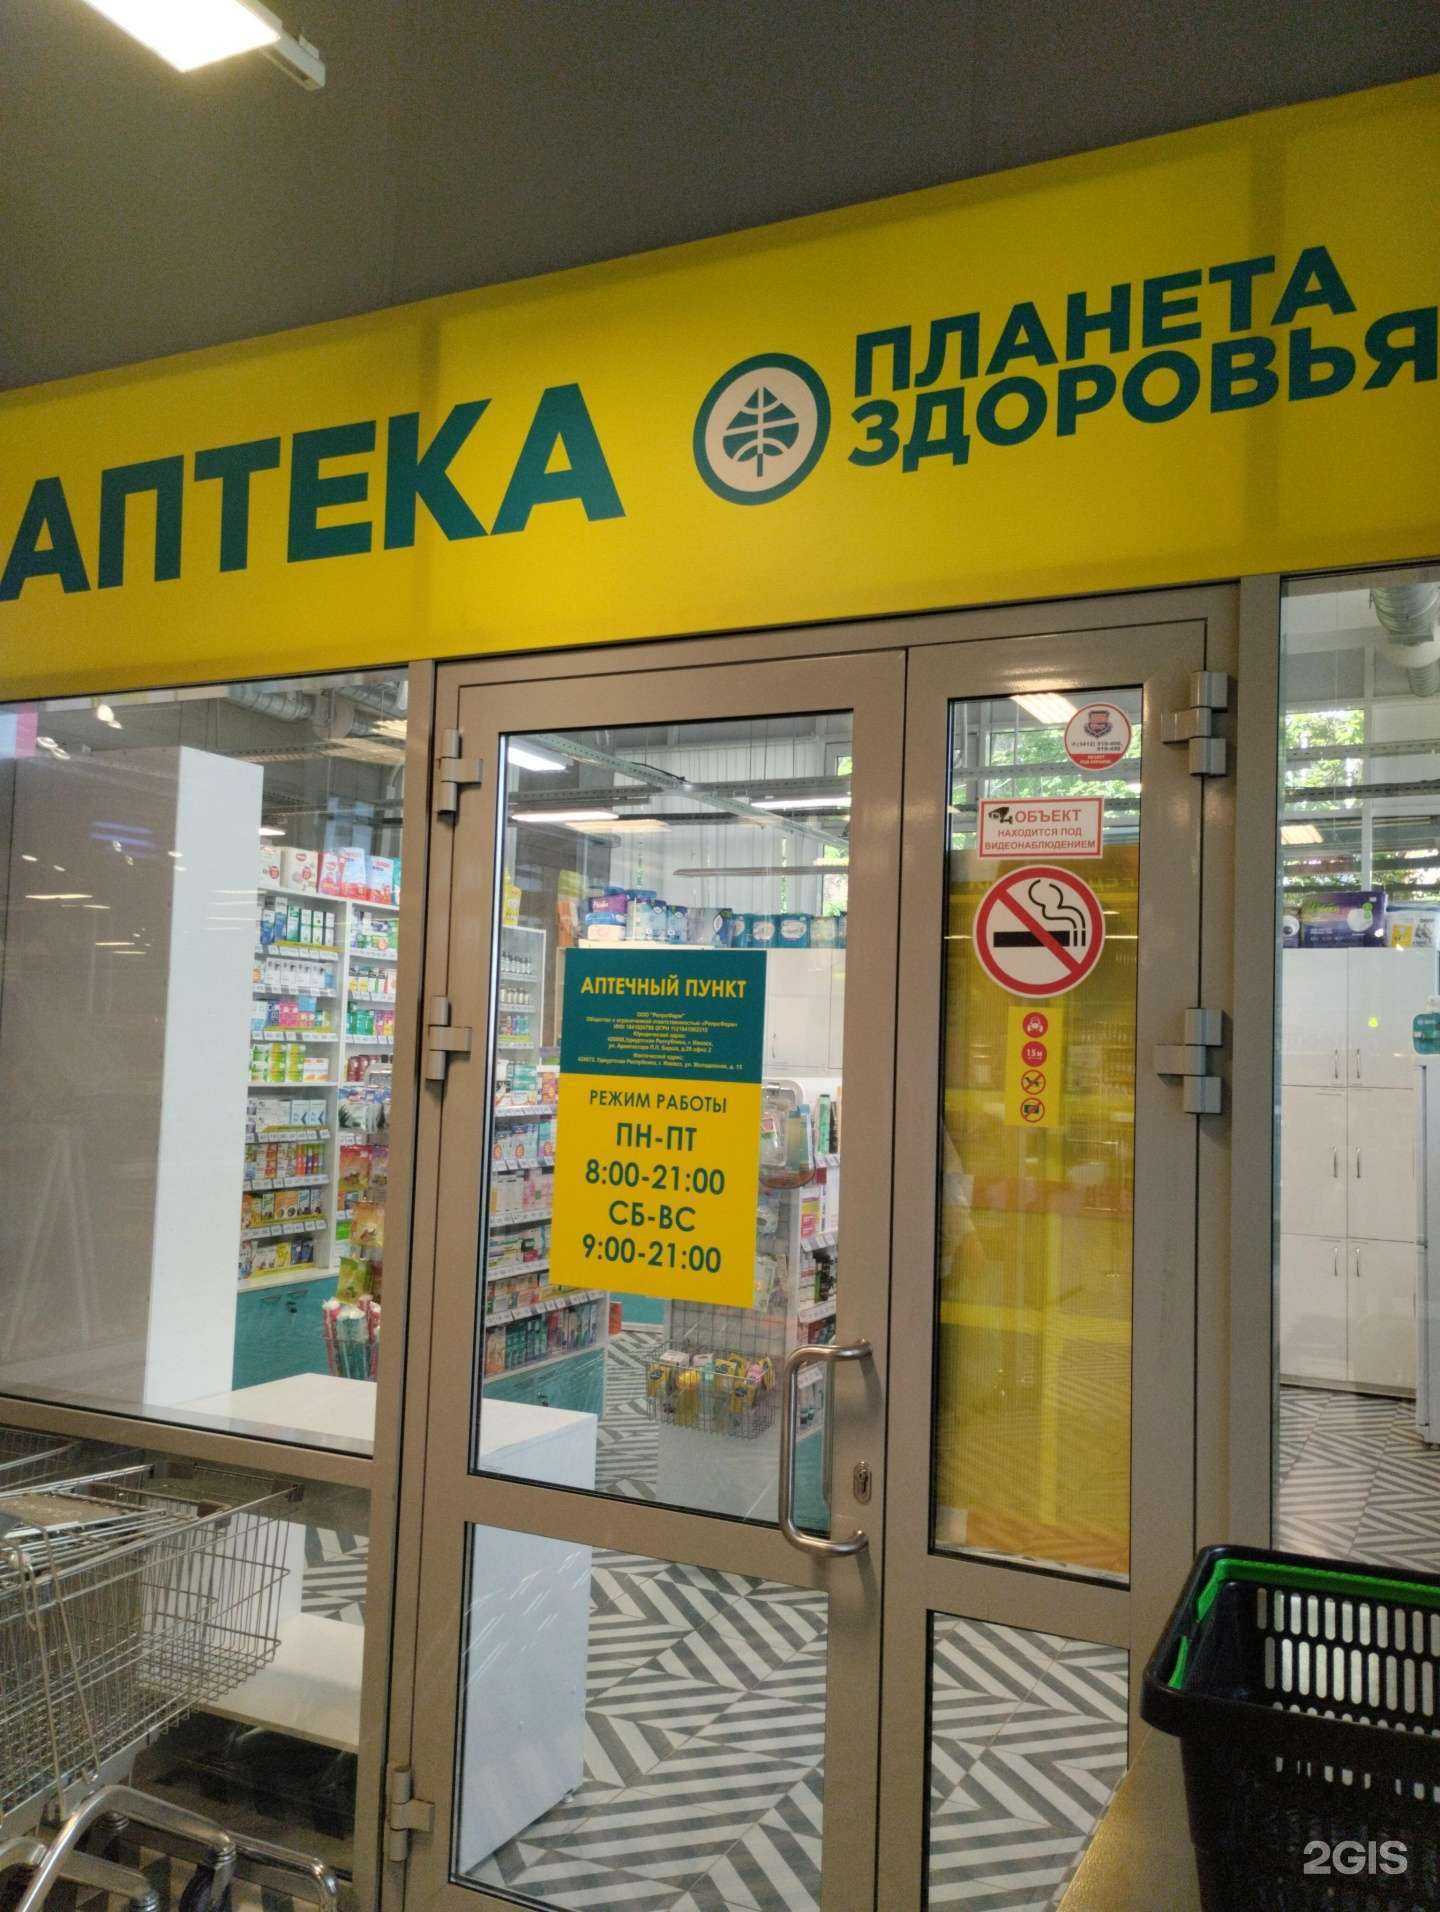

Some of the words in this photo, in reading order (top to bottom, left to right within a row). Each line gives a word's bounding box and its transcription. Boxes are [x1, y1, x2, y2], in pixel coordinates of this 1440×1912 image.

[854, 245, 1357, 399] ПЛАНЕТА
[848, 306, 1439, 474] ЗДОРОВЬЯ
[0, 383, 626, 600] АПТЕКА
[1014, 809, 1082, 823] ОБЪЕКТ
[984, 839, 1096, 850] ВИДЕОНАБЛЮДЕНИЕМ
[997, 828, 1058, 838] НАХОДИТСЯ
[1060, 827, 1082, 837] ПОД
[580, 974, 680, 997] АПТЕЧНЫЙ
[685, 979, 748, 998] ПУНКТ
[589, 1089, 651, 1109] РЕЖИМ
[656, 1094, 727, 1114] РАБОТЫ
[616, 1122, 698, 1151] ПН-ПТ
[585, 1158, 725, 1195] 8:00-21:00
[608, 1200, 697, 1232] СБ-ВС
[582, 1233, 721, 1274] 9:00-21:00
